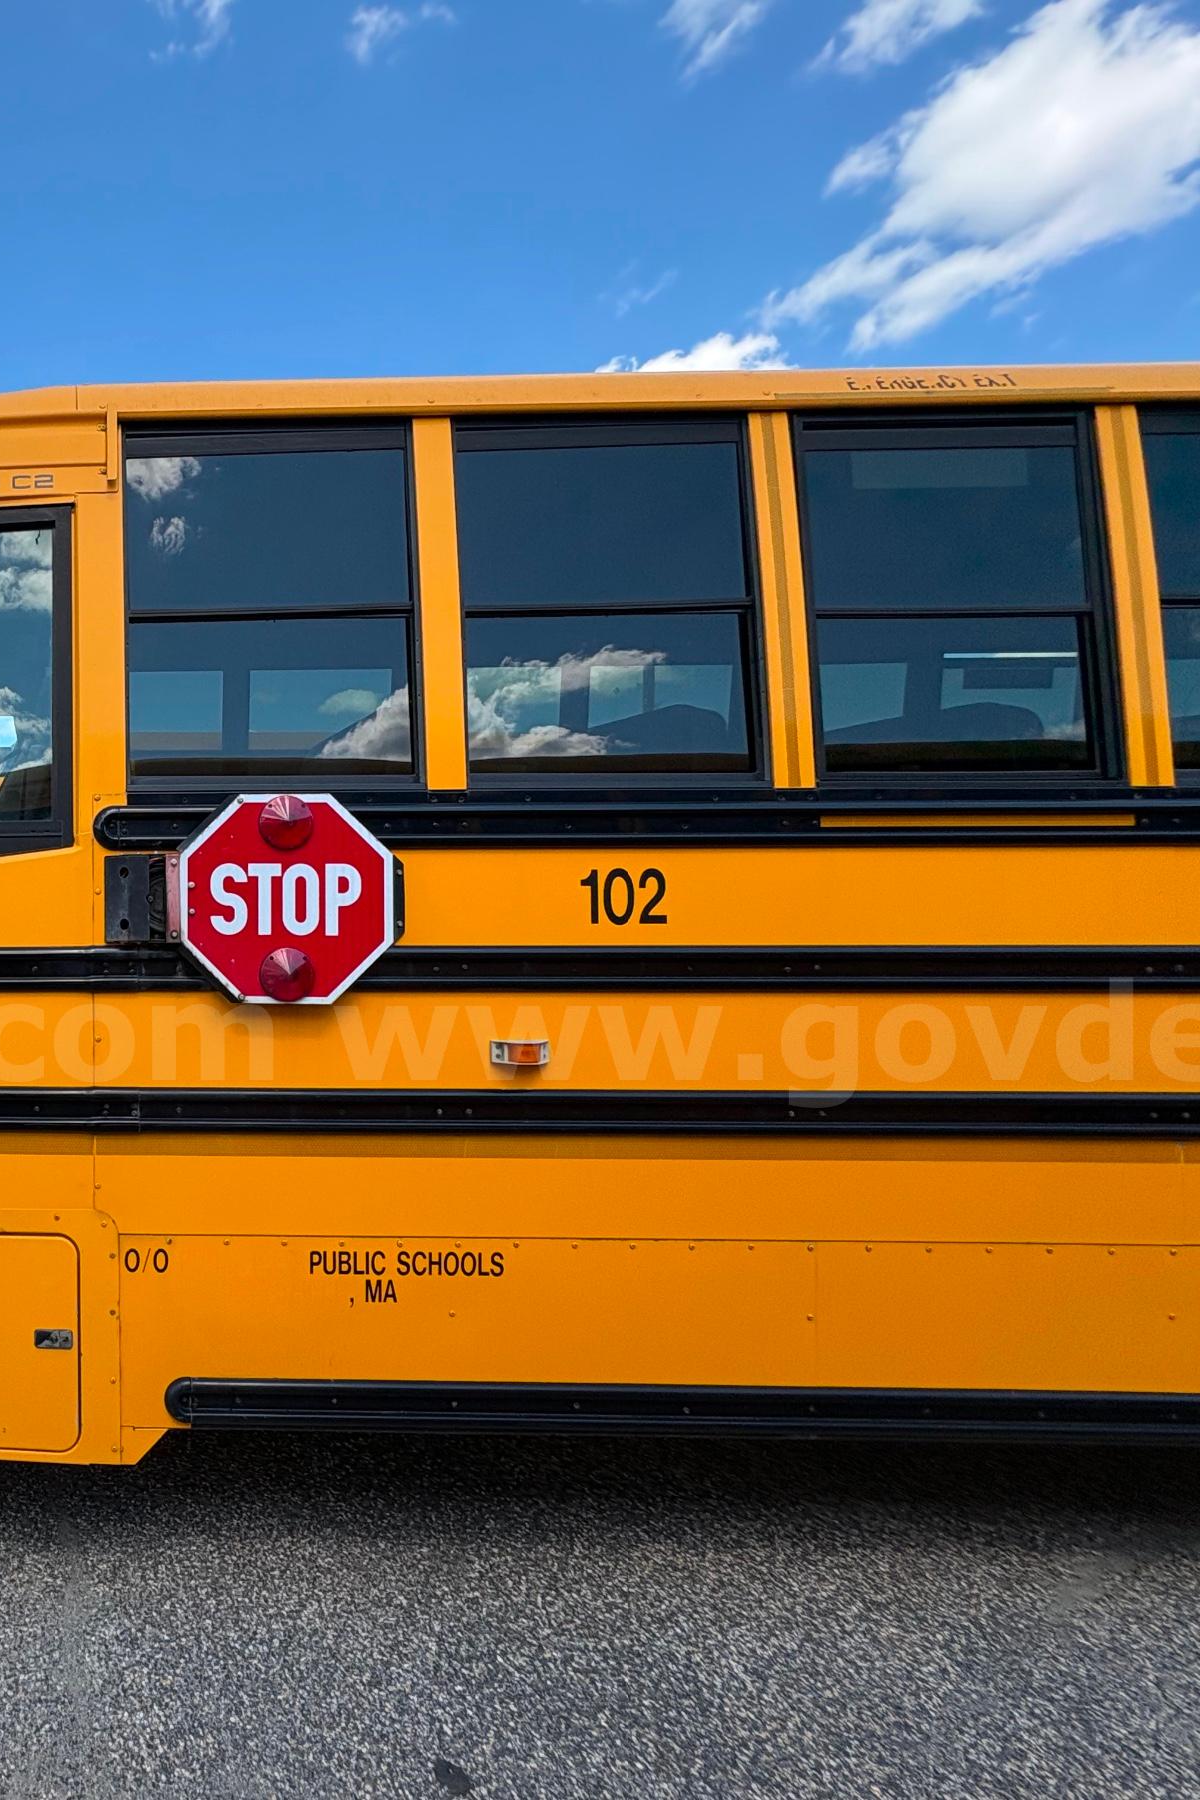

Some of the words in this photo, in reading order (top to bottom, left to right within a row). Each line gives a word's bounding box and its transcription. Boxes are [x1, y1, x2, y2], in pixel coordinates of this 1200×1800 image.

[972, 373, 1018, 388] EXT
[12, 474, 54, 490] C2
[210, 863, 362, 937] STOP
[580, 868, 668, 926] 102
[310, 1251, 386, 1275] PUBLIC
[397, 1251, 505, 1277] SCHOOLS
[365, 1279, 398, 1303] MA
